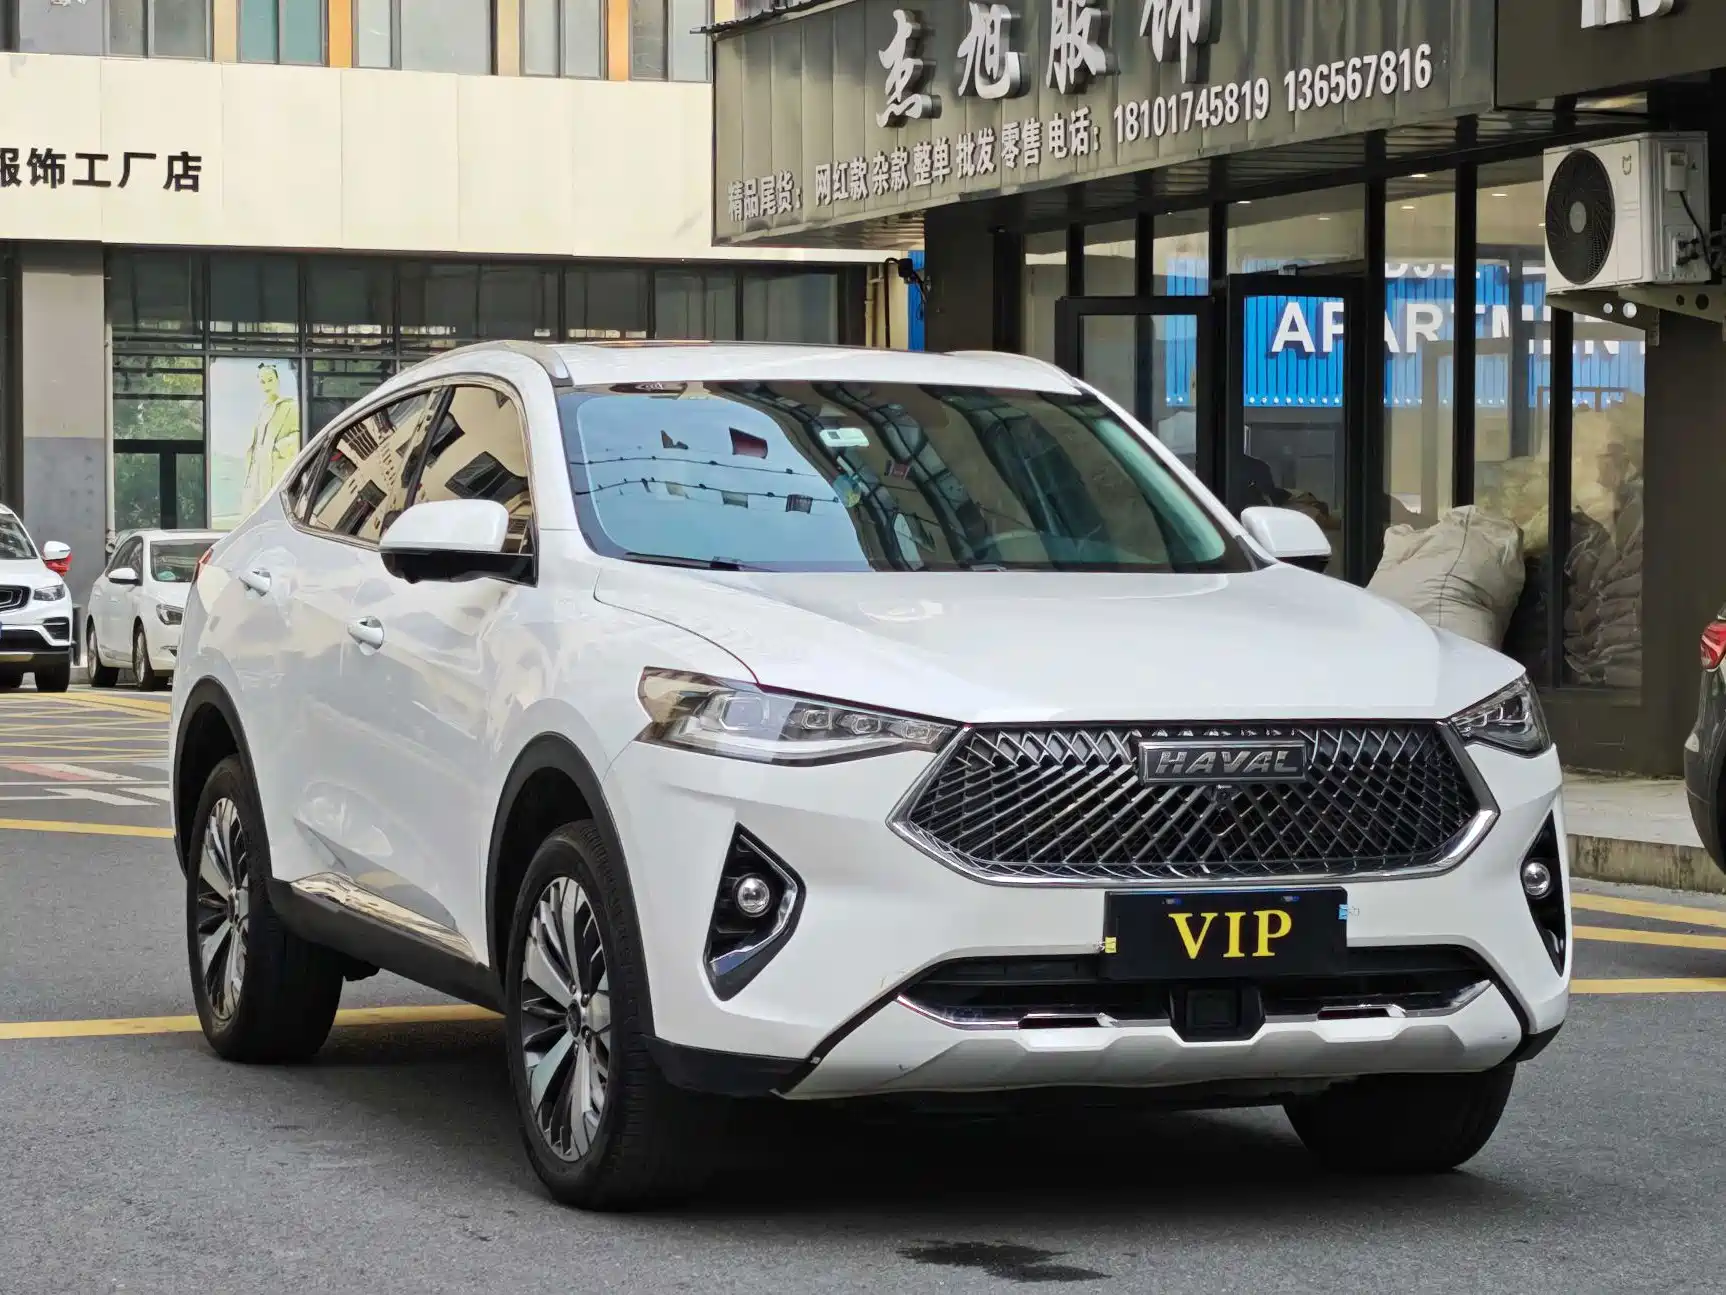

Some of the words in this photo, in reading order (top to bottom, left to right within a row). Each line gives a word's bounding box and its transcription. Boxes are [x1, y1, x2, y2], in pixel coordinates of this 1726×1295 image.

[815, 155, 869, 207] 网红款
[871, 147, 909, 195] 杂款
[913, 136, 952, 187] 整单
[956, 127, 997, 178] 批发
[1001, 118, 1043, 169] 零售
[1050, 106, 1100, 160] 电话：
[1114, 78, 1270, 144] 18101745819
[1284, 43, 1433, 113] 136567816
[1155, 750, 1298, 774] HAVAL
[1168, 909, 1292, 959] VIP
